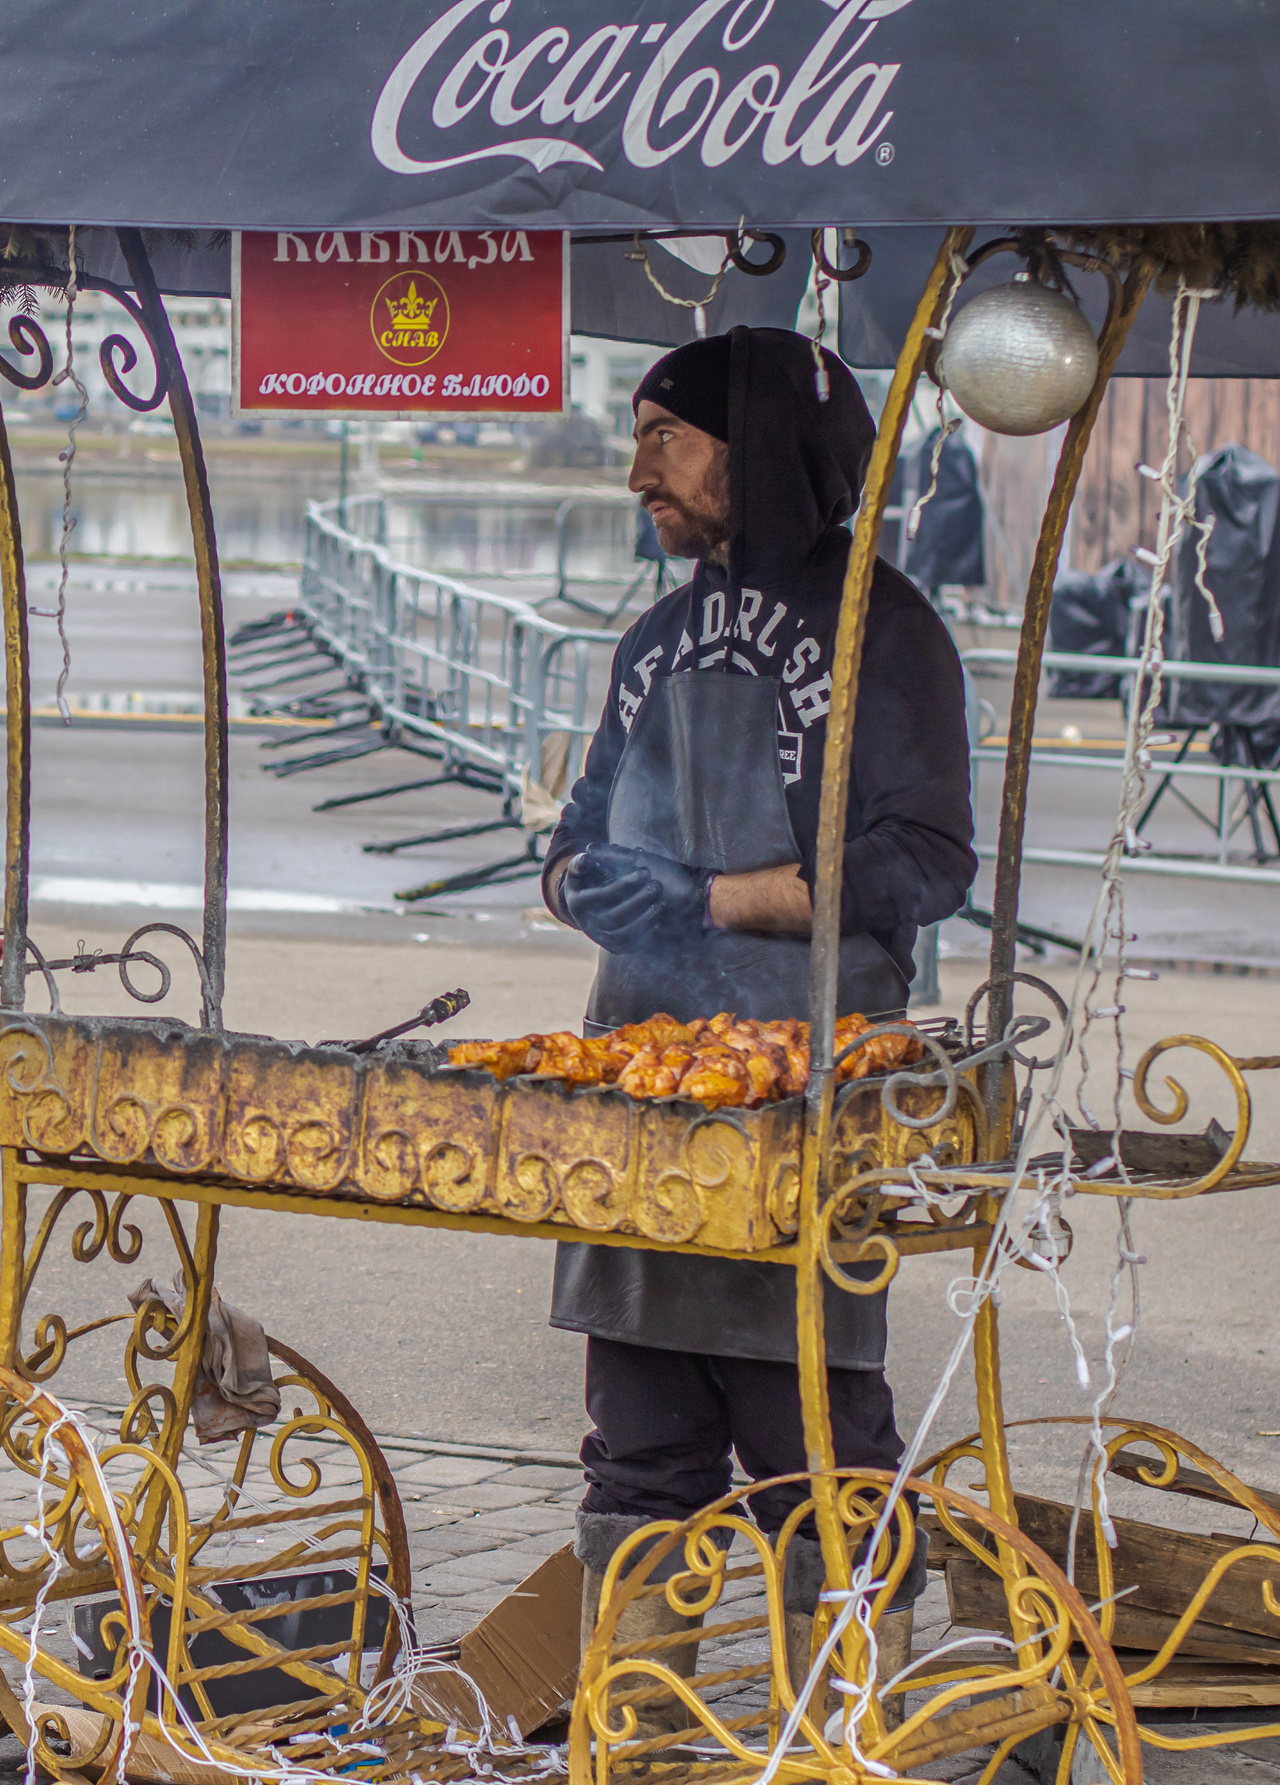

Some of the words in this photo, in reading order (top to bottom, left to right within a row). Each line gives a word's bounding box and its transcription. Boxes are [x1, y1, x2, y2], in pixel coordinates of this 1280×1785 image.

[371, 0, 912, 174] Coca-Cola
[258, 372, 437, 396] КОРОННОЕ
[441, 372, 550, 397] БЛЮДО
